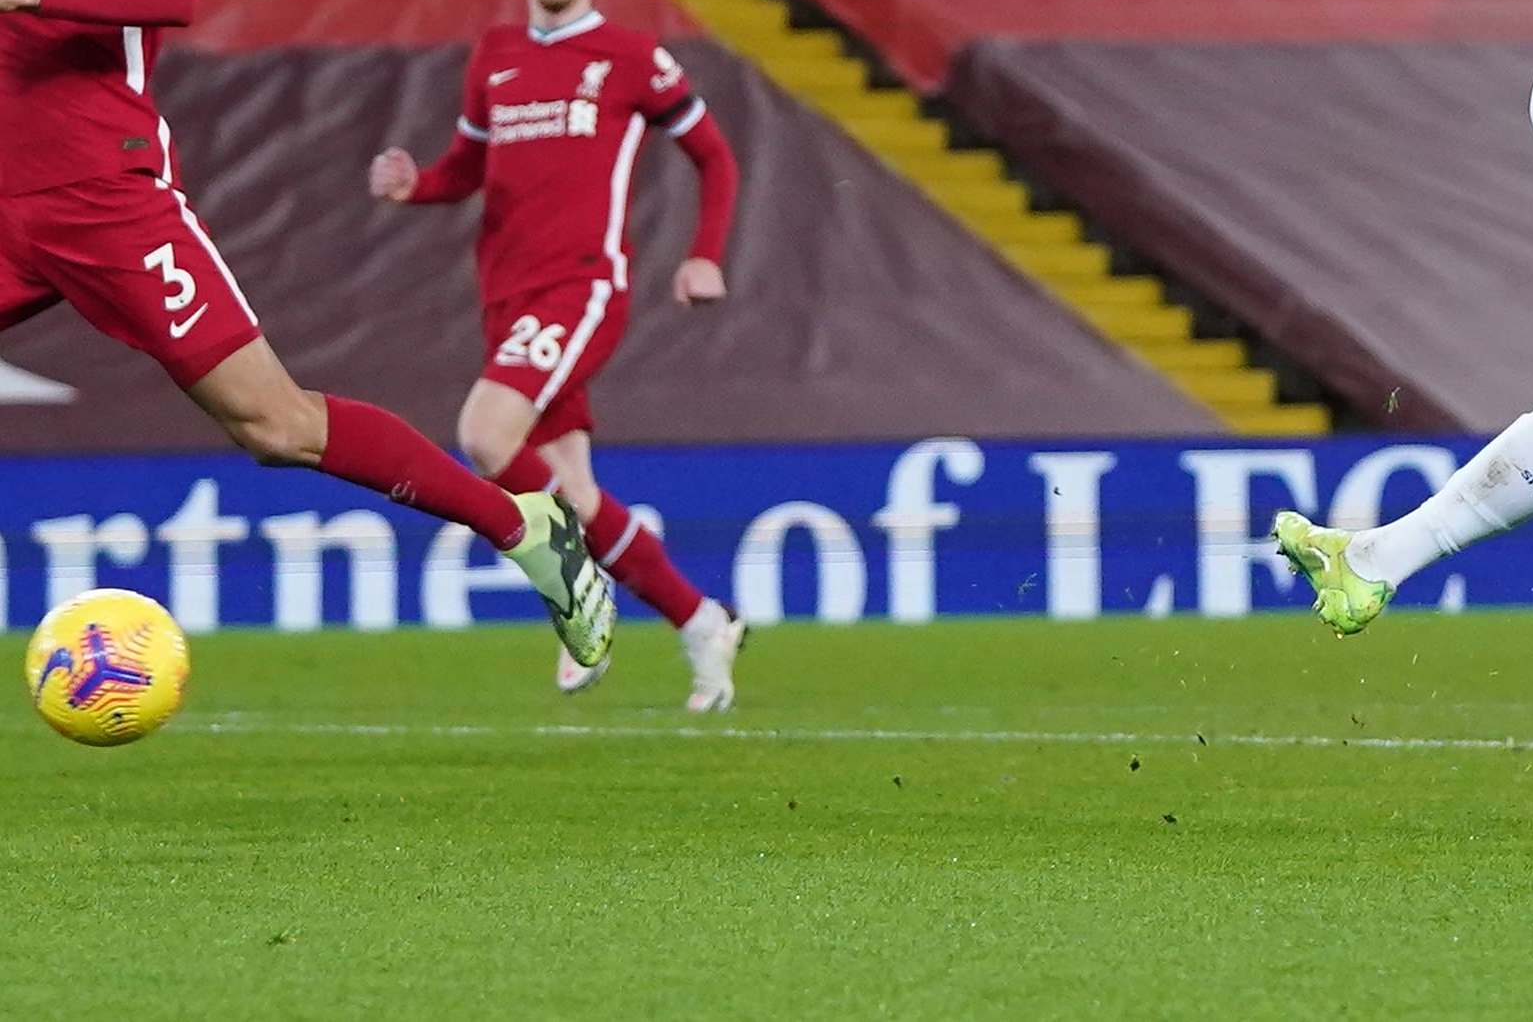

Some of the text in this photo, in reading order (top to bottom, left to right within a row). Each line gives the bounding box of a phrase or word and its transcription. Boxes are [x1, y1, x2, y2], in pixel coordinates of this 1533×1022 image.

[143, 242, 196, 312] 3
[495, 314, 567, 371] 26
[732, 435, 986, 626] of
